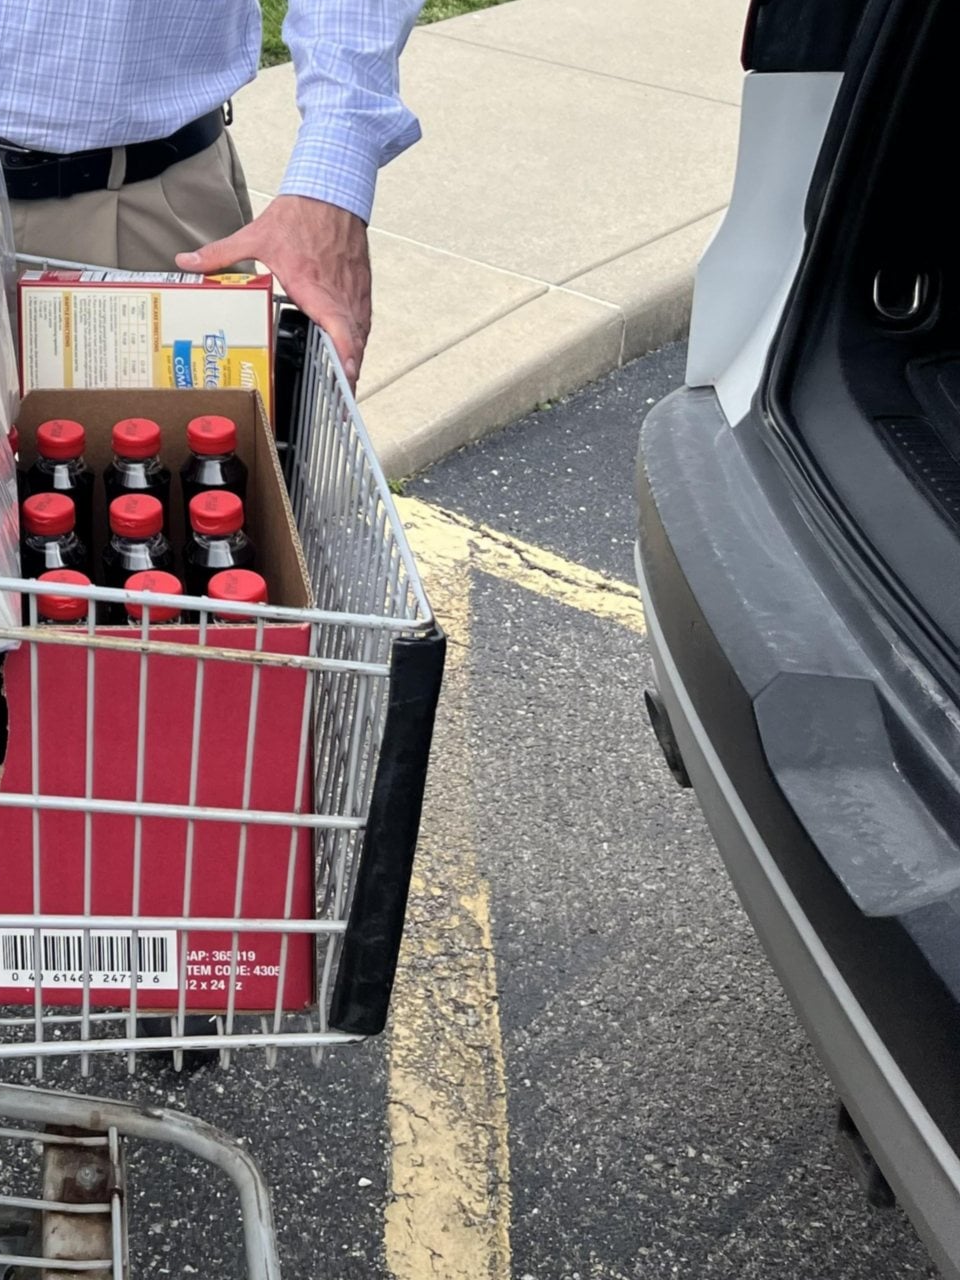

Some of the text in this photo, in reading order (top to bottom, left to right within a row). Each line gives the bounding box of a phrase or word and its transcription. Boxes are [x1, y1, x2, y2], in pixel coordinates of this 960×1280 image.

[11, 972, 19, 981] 0
[152, 975, 160, 984] 6
[200, 982, 208, 990] x
[210, 980, 226, 991] 24
